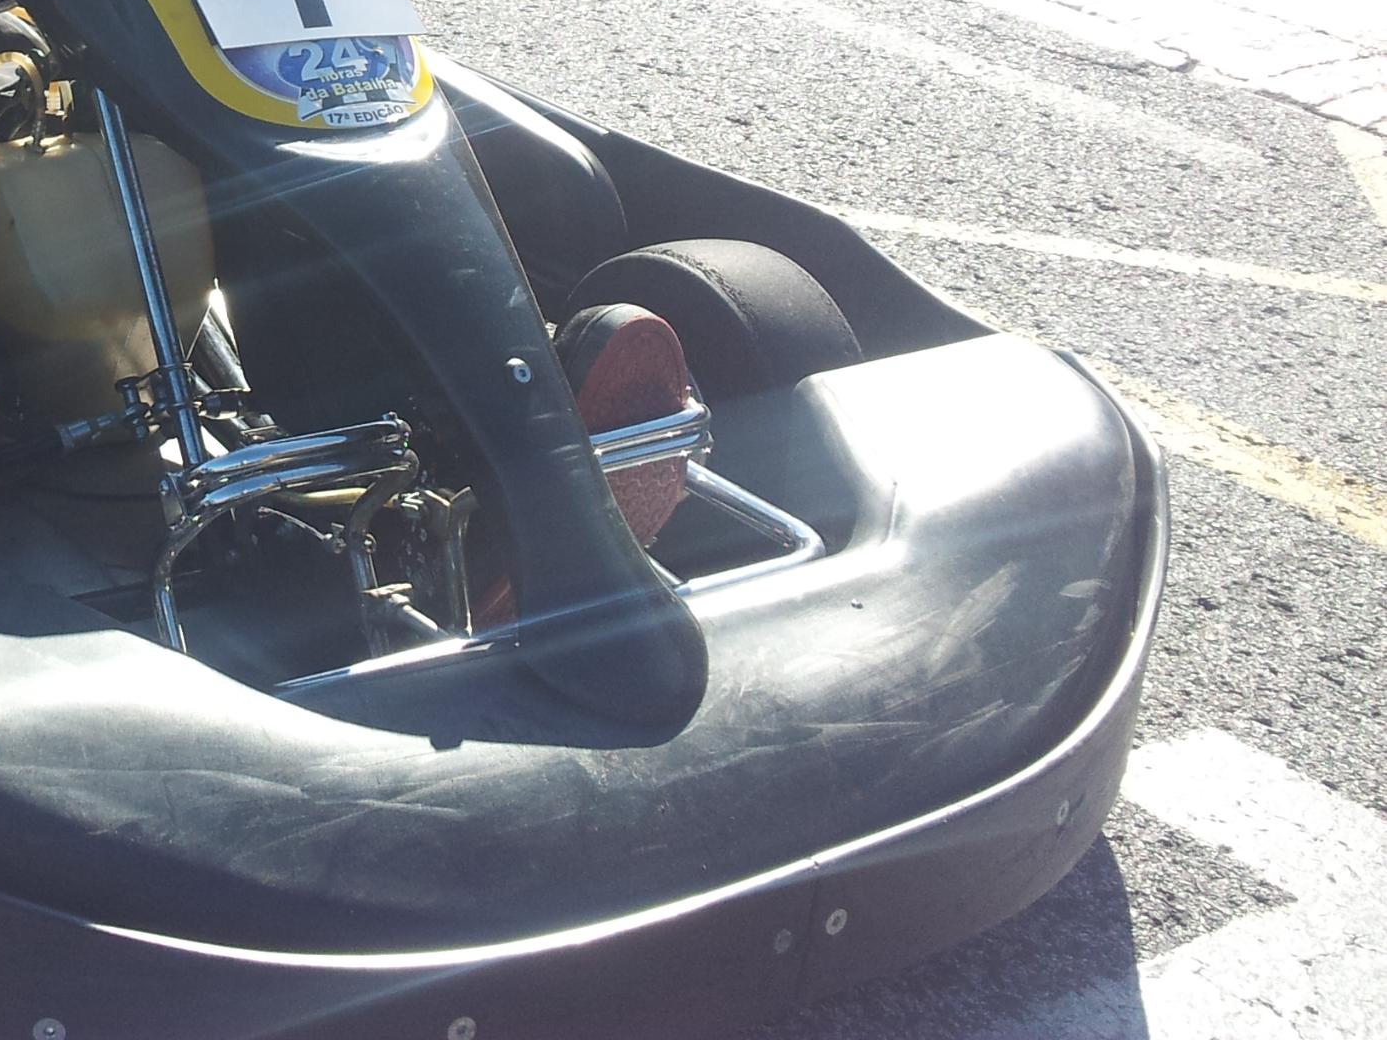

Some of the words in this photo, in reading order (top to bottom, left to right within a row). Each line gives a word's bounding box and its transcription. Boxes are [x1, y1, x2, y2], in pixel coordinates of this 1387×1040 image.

[288, 37, 368, 82] 24
[306, 87, 329, 101] da
[332, 78, 396, 97] Batalha
[355, 104, 404, 124] EDIÇÃO
